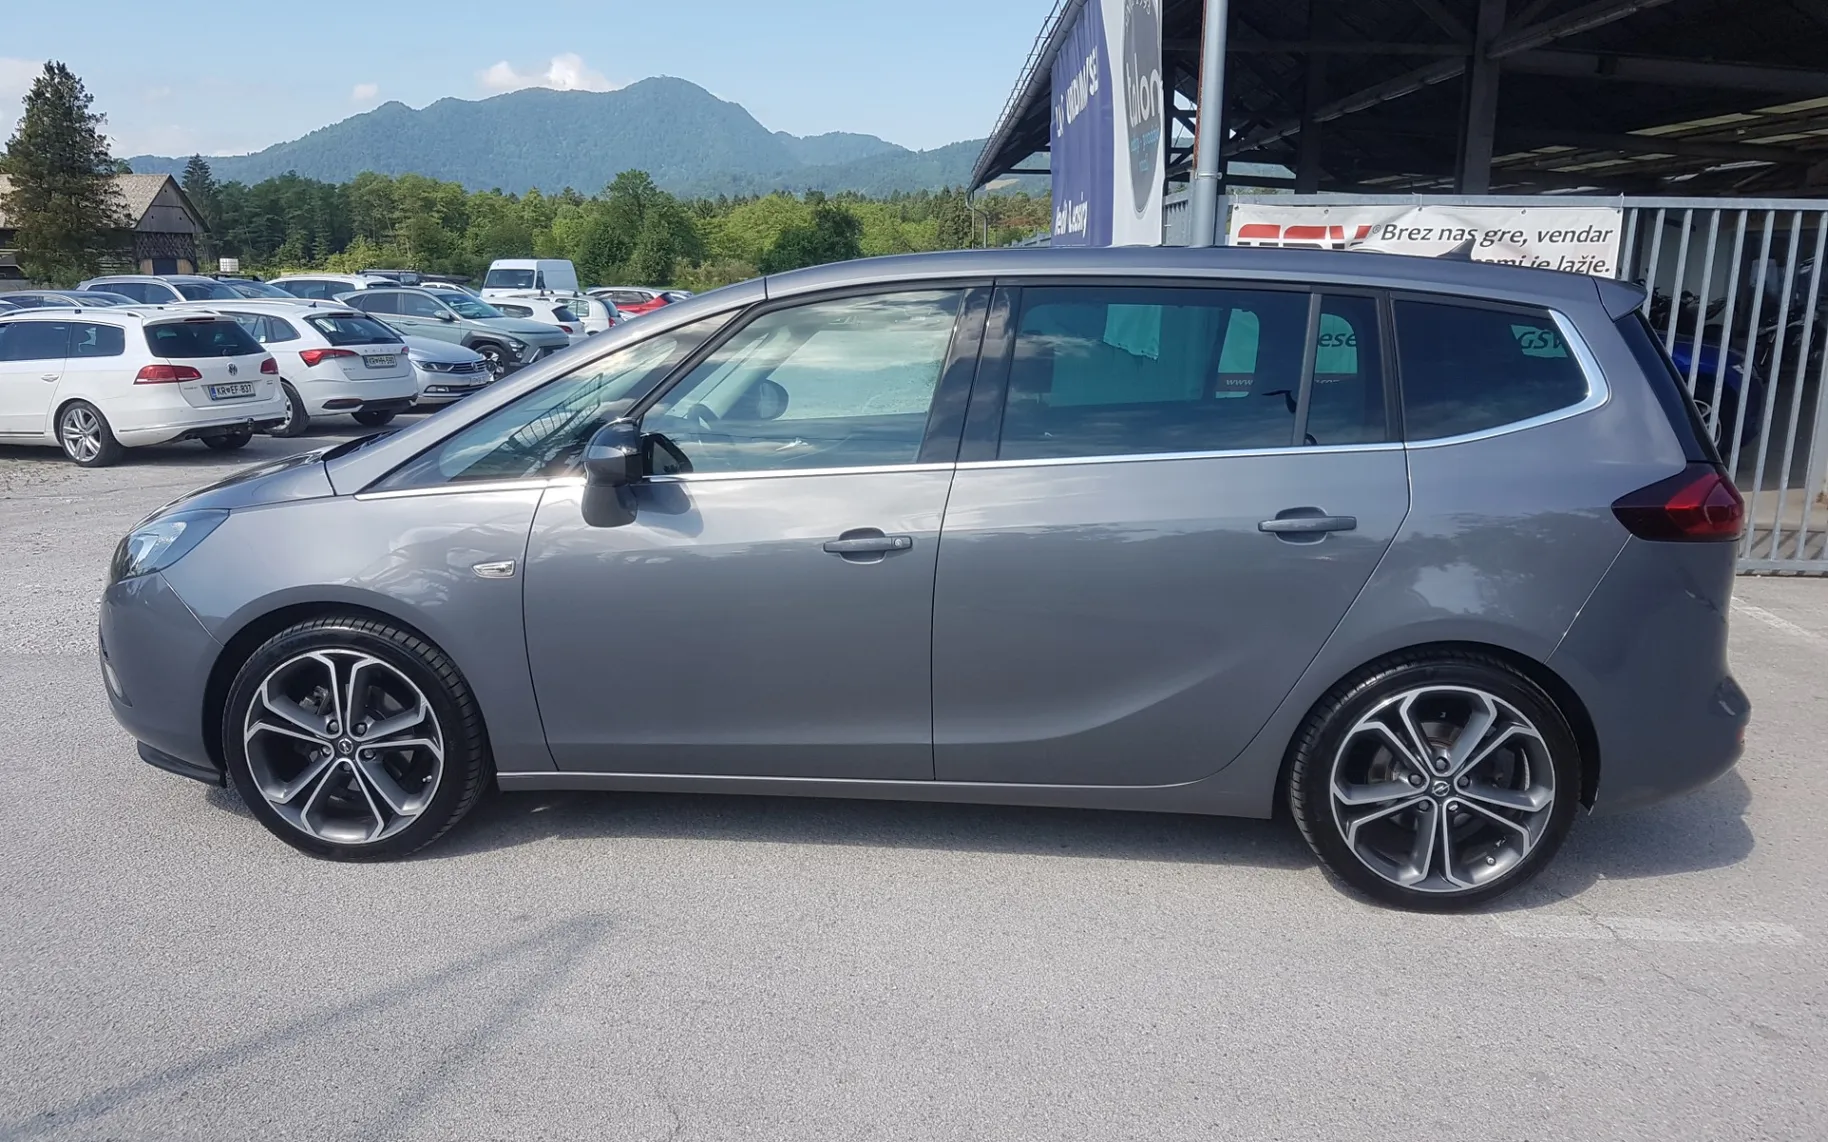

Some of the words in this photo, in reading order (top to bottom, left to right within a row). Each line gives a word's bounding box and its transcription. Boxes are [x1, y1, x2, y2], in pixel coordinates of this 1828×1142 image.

[1381, 224, 1432, 241] Brez
[1438, 228, 1478, 242] nas
[1480, 229, 1529, 248] gre,
[1538, 225, 1614, 243] vendar
[1557, 255, 1611, 275] lažje.
